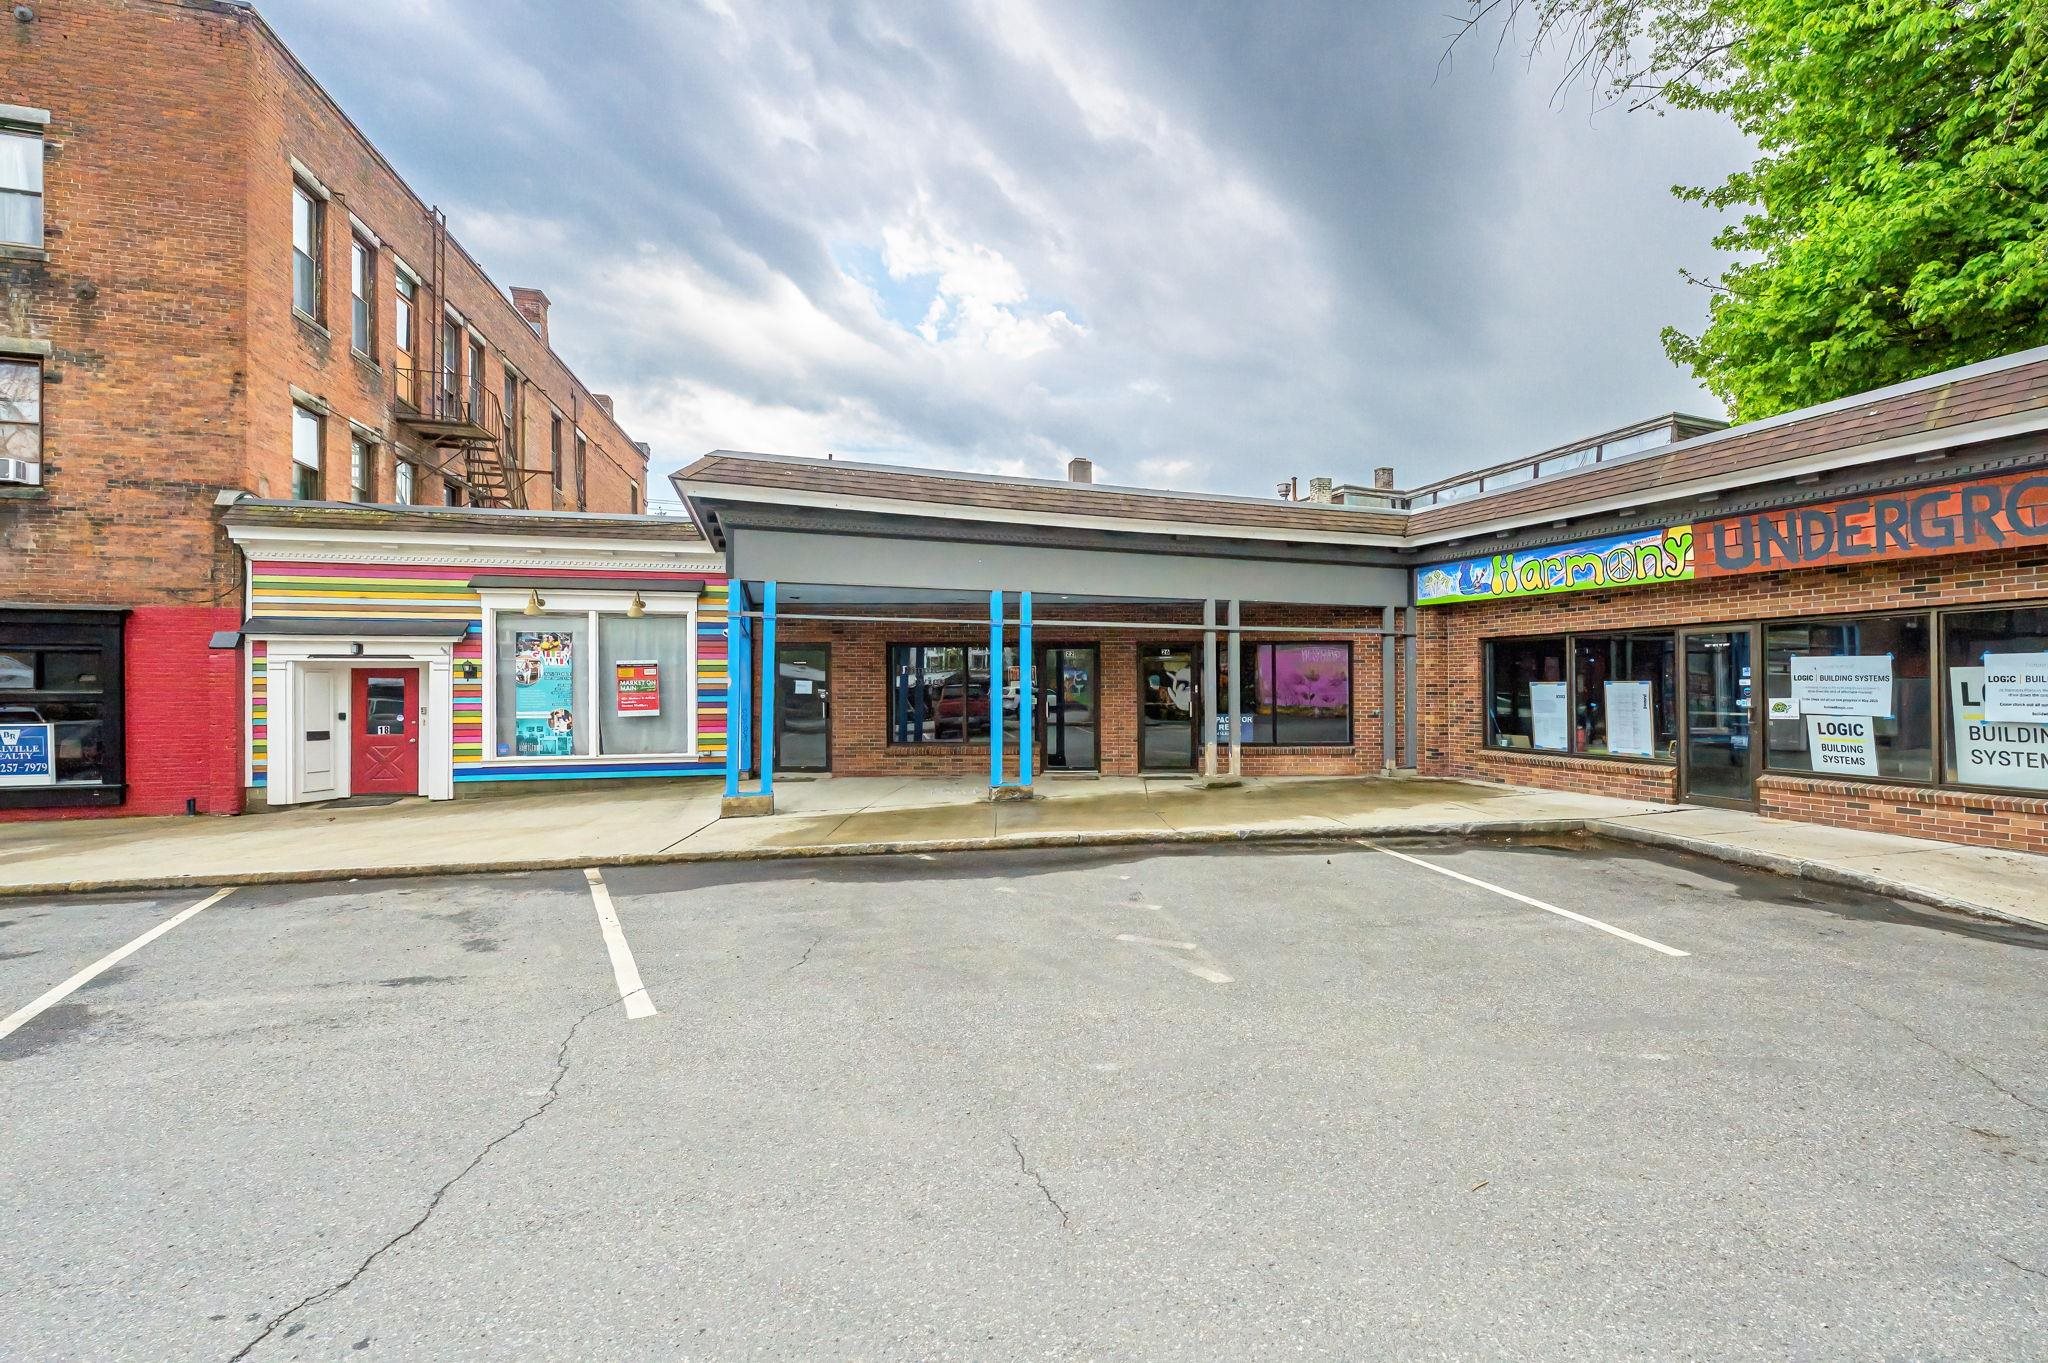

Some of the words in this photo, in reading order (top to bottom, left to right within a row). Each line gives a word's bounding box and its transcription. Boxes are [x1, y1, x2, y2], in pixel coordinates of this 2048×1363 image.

[1490, 532, 1694, 596] Harmony
[1793, 674, 1814, 682] LOGIC
[1820, 674, 1853, 682] BUILDING
[1854, 674, 1890, 683] SYSTEMS
[1988, 675, 2016, 683] LOGIC
[379, 726, 389, 734] 18
[1817, 722, 1865, 736] LOGIC
[1821, 743, 1864, 754] BUILDING
[1822, 754, 1866, 766] SYSTEMS
[0, 763, 48, 772] 257-7979
